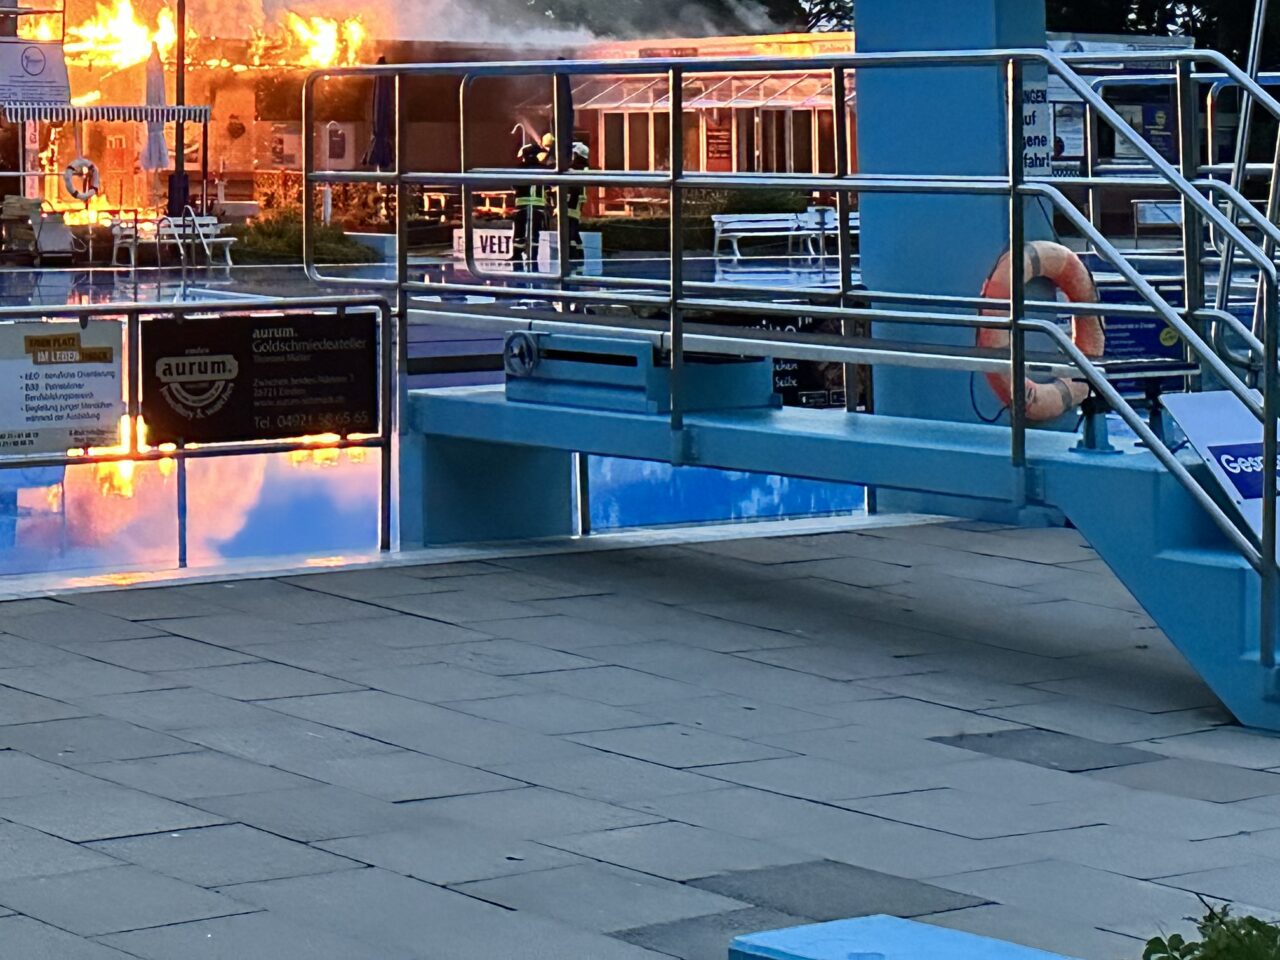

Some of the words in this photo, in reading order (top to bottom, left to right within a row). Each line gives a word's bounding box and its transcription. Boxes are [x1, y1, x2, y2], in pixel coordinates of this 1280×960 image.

[1023, 110, 1036, 126] uf
[1024, 152, 1050, 168] fahr!
[162, 360, 233, 377] aurum.
